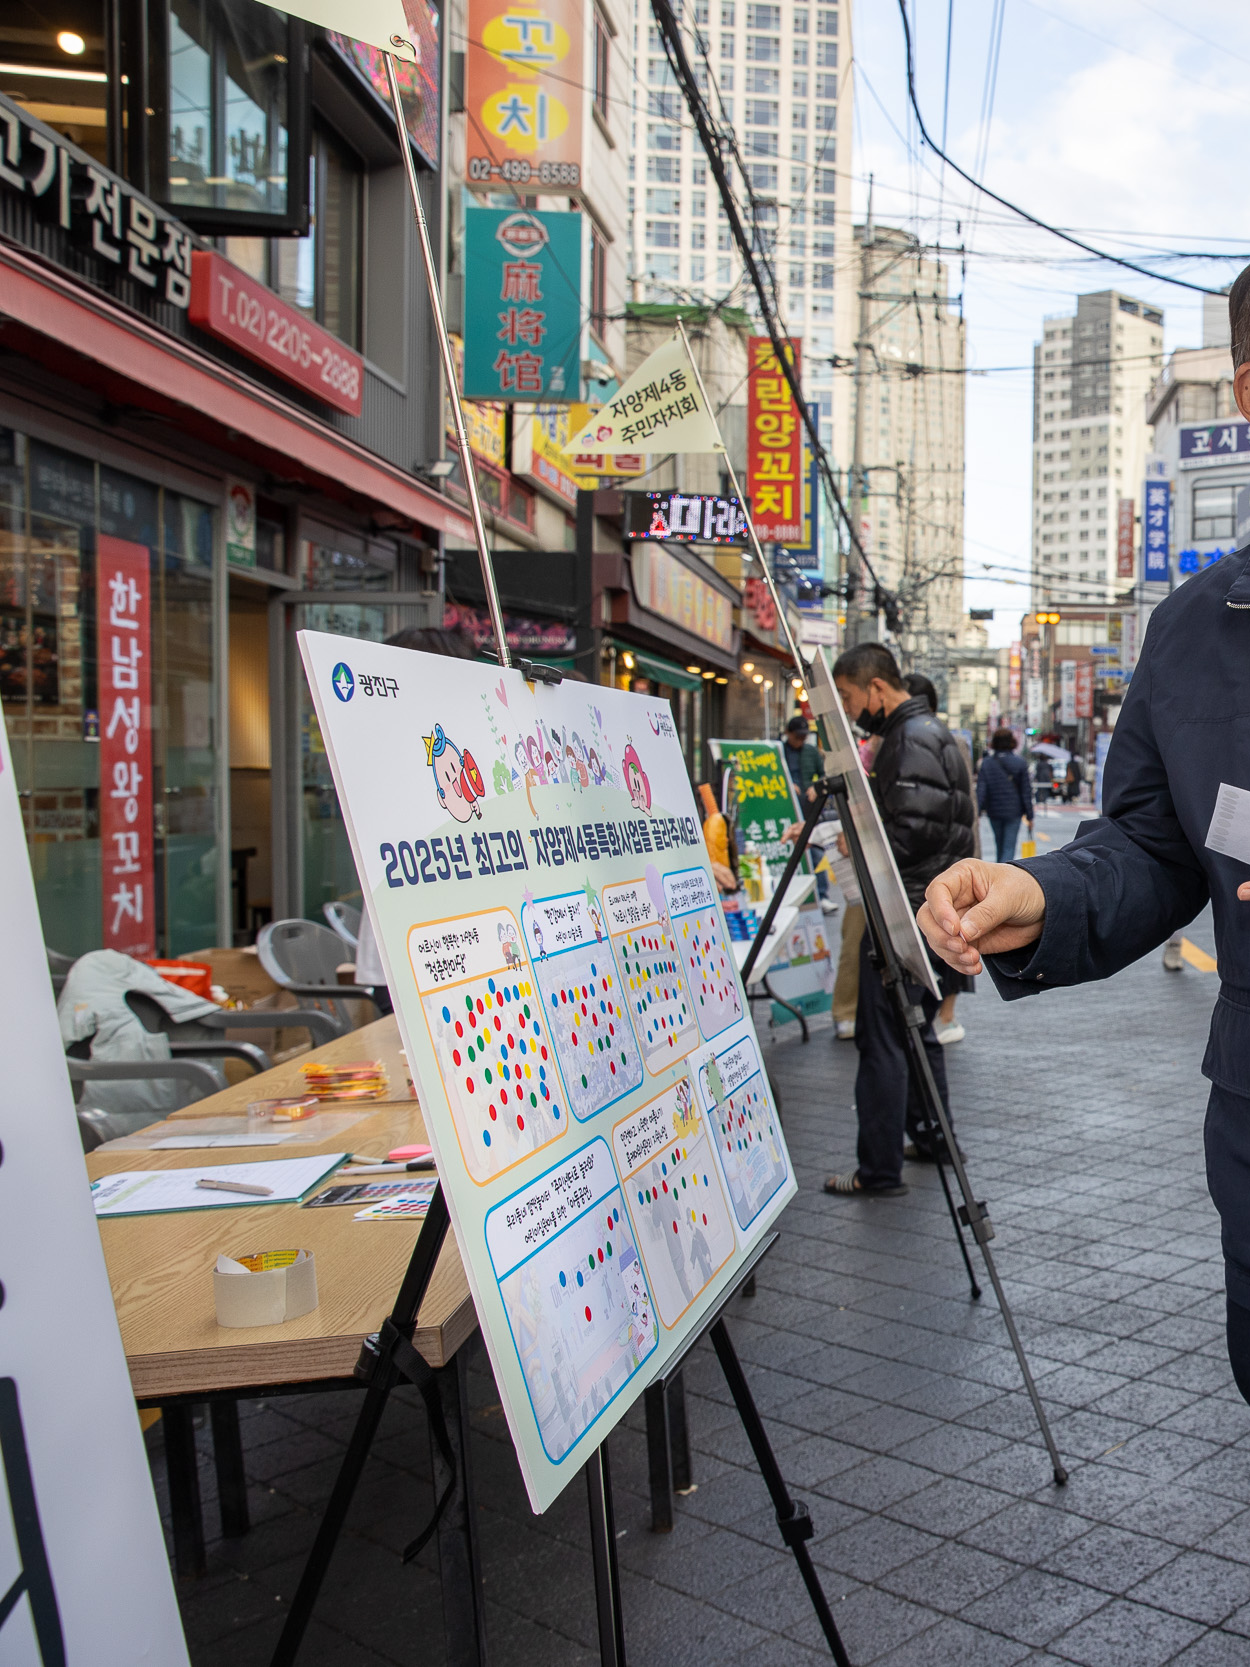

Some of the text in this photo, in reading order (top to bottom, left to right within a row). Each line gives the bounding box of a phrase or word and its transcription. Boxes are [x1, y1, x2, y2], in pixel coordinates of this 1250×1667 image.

[498, 16, 556, 141] 꼬치
[85, 163, 192, 310] 전문점
[494, 262, 547, 392] 麻将馆
[609, 368, 687, 419] 자양제4동
[620, 392, 700, 445] 주민자치회
[357, 673, 400, 699] 광진구
[106, 570, 143, 935] 한남성왕꼬치
[379, 833, 473, 889] 2025년
[470, 829, 529, 876] 최고의
[649, 816, 701, 852] 골라주세요!
[418, 939, 442, 955] 어르신이
[441, 933, 460, 951] 행복한
[555, 931, 567, 944] 어린이
[620, 1107, 663, 1148] 안전하고 시원한 여름나기
[651, 1125, 669, 1145] 지원사업
[506, 1206, 528, 1230] 우리동네
[525, 1190, 551, 1216] 깜짝놀이터
[524, 1210, 558, 1244] 어린이집원아를
[556, 1204, 568, 1221] 위한
